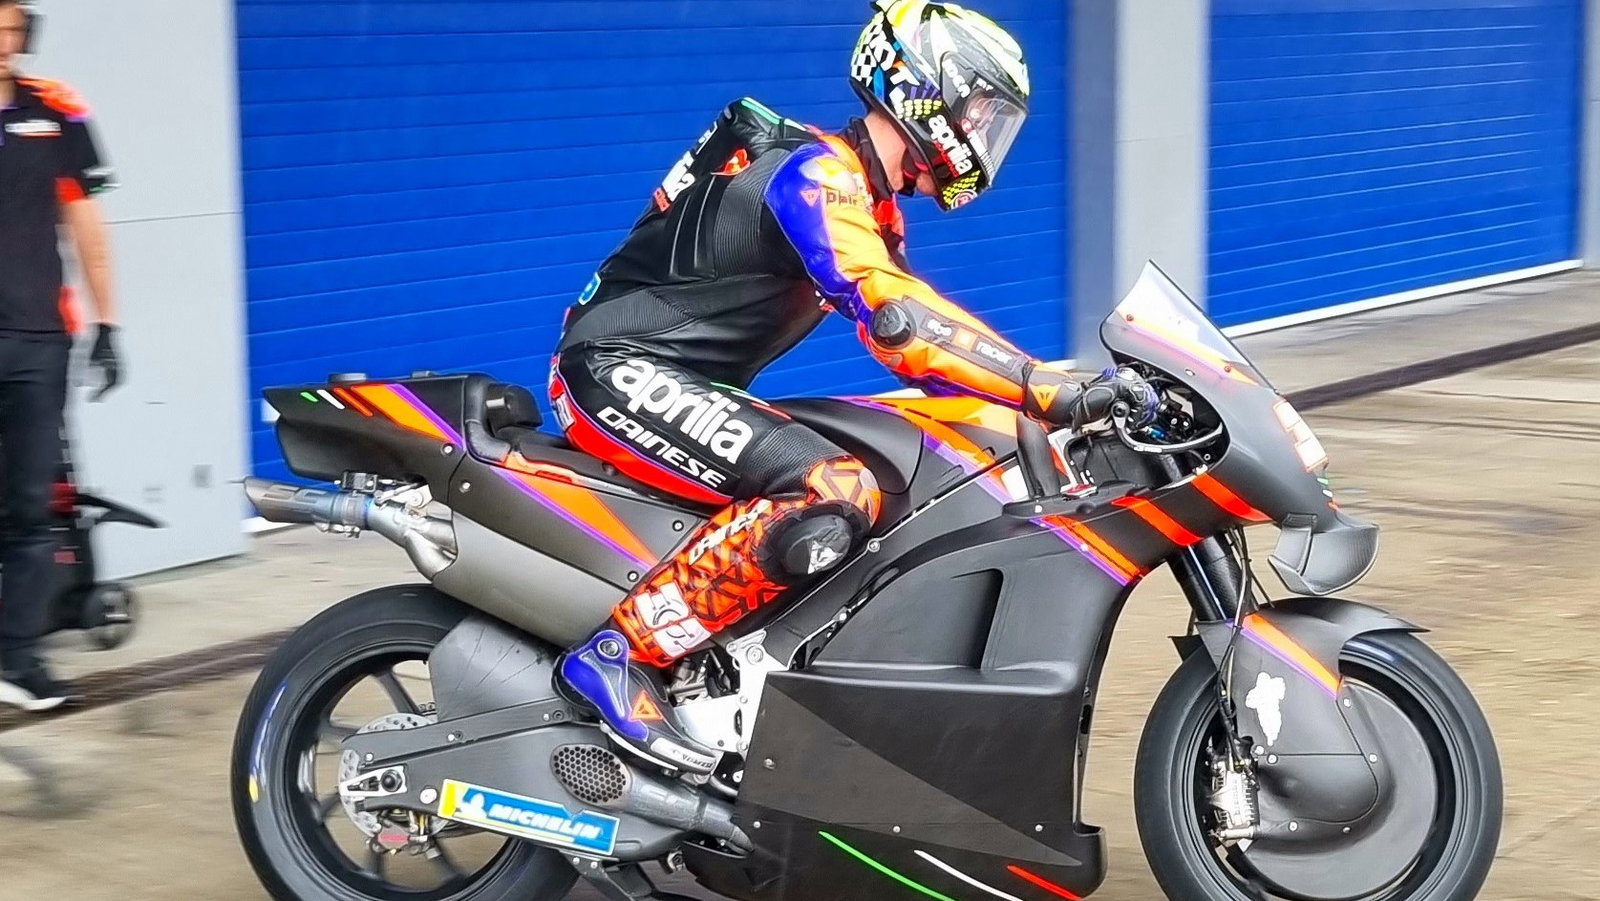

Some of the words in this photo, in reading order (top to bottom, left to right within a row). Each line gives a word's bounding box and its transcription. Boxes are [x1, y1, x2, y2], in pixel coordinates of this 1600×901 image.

[928, 114, 973, 176] aprilia
[597, 406, 727, 488] DAINESE
[611, 359, 754, 465] aprilia
[488, 803, 602, 839] MICHELIN
